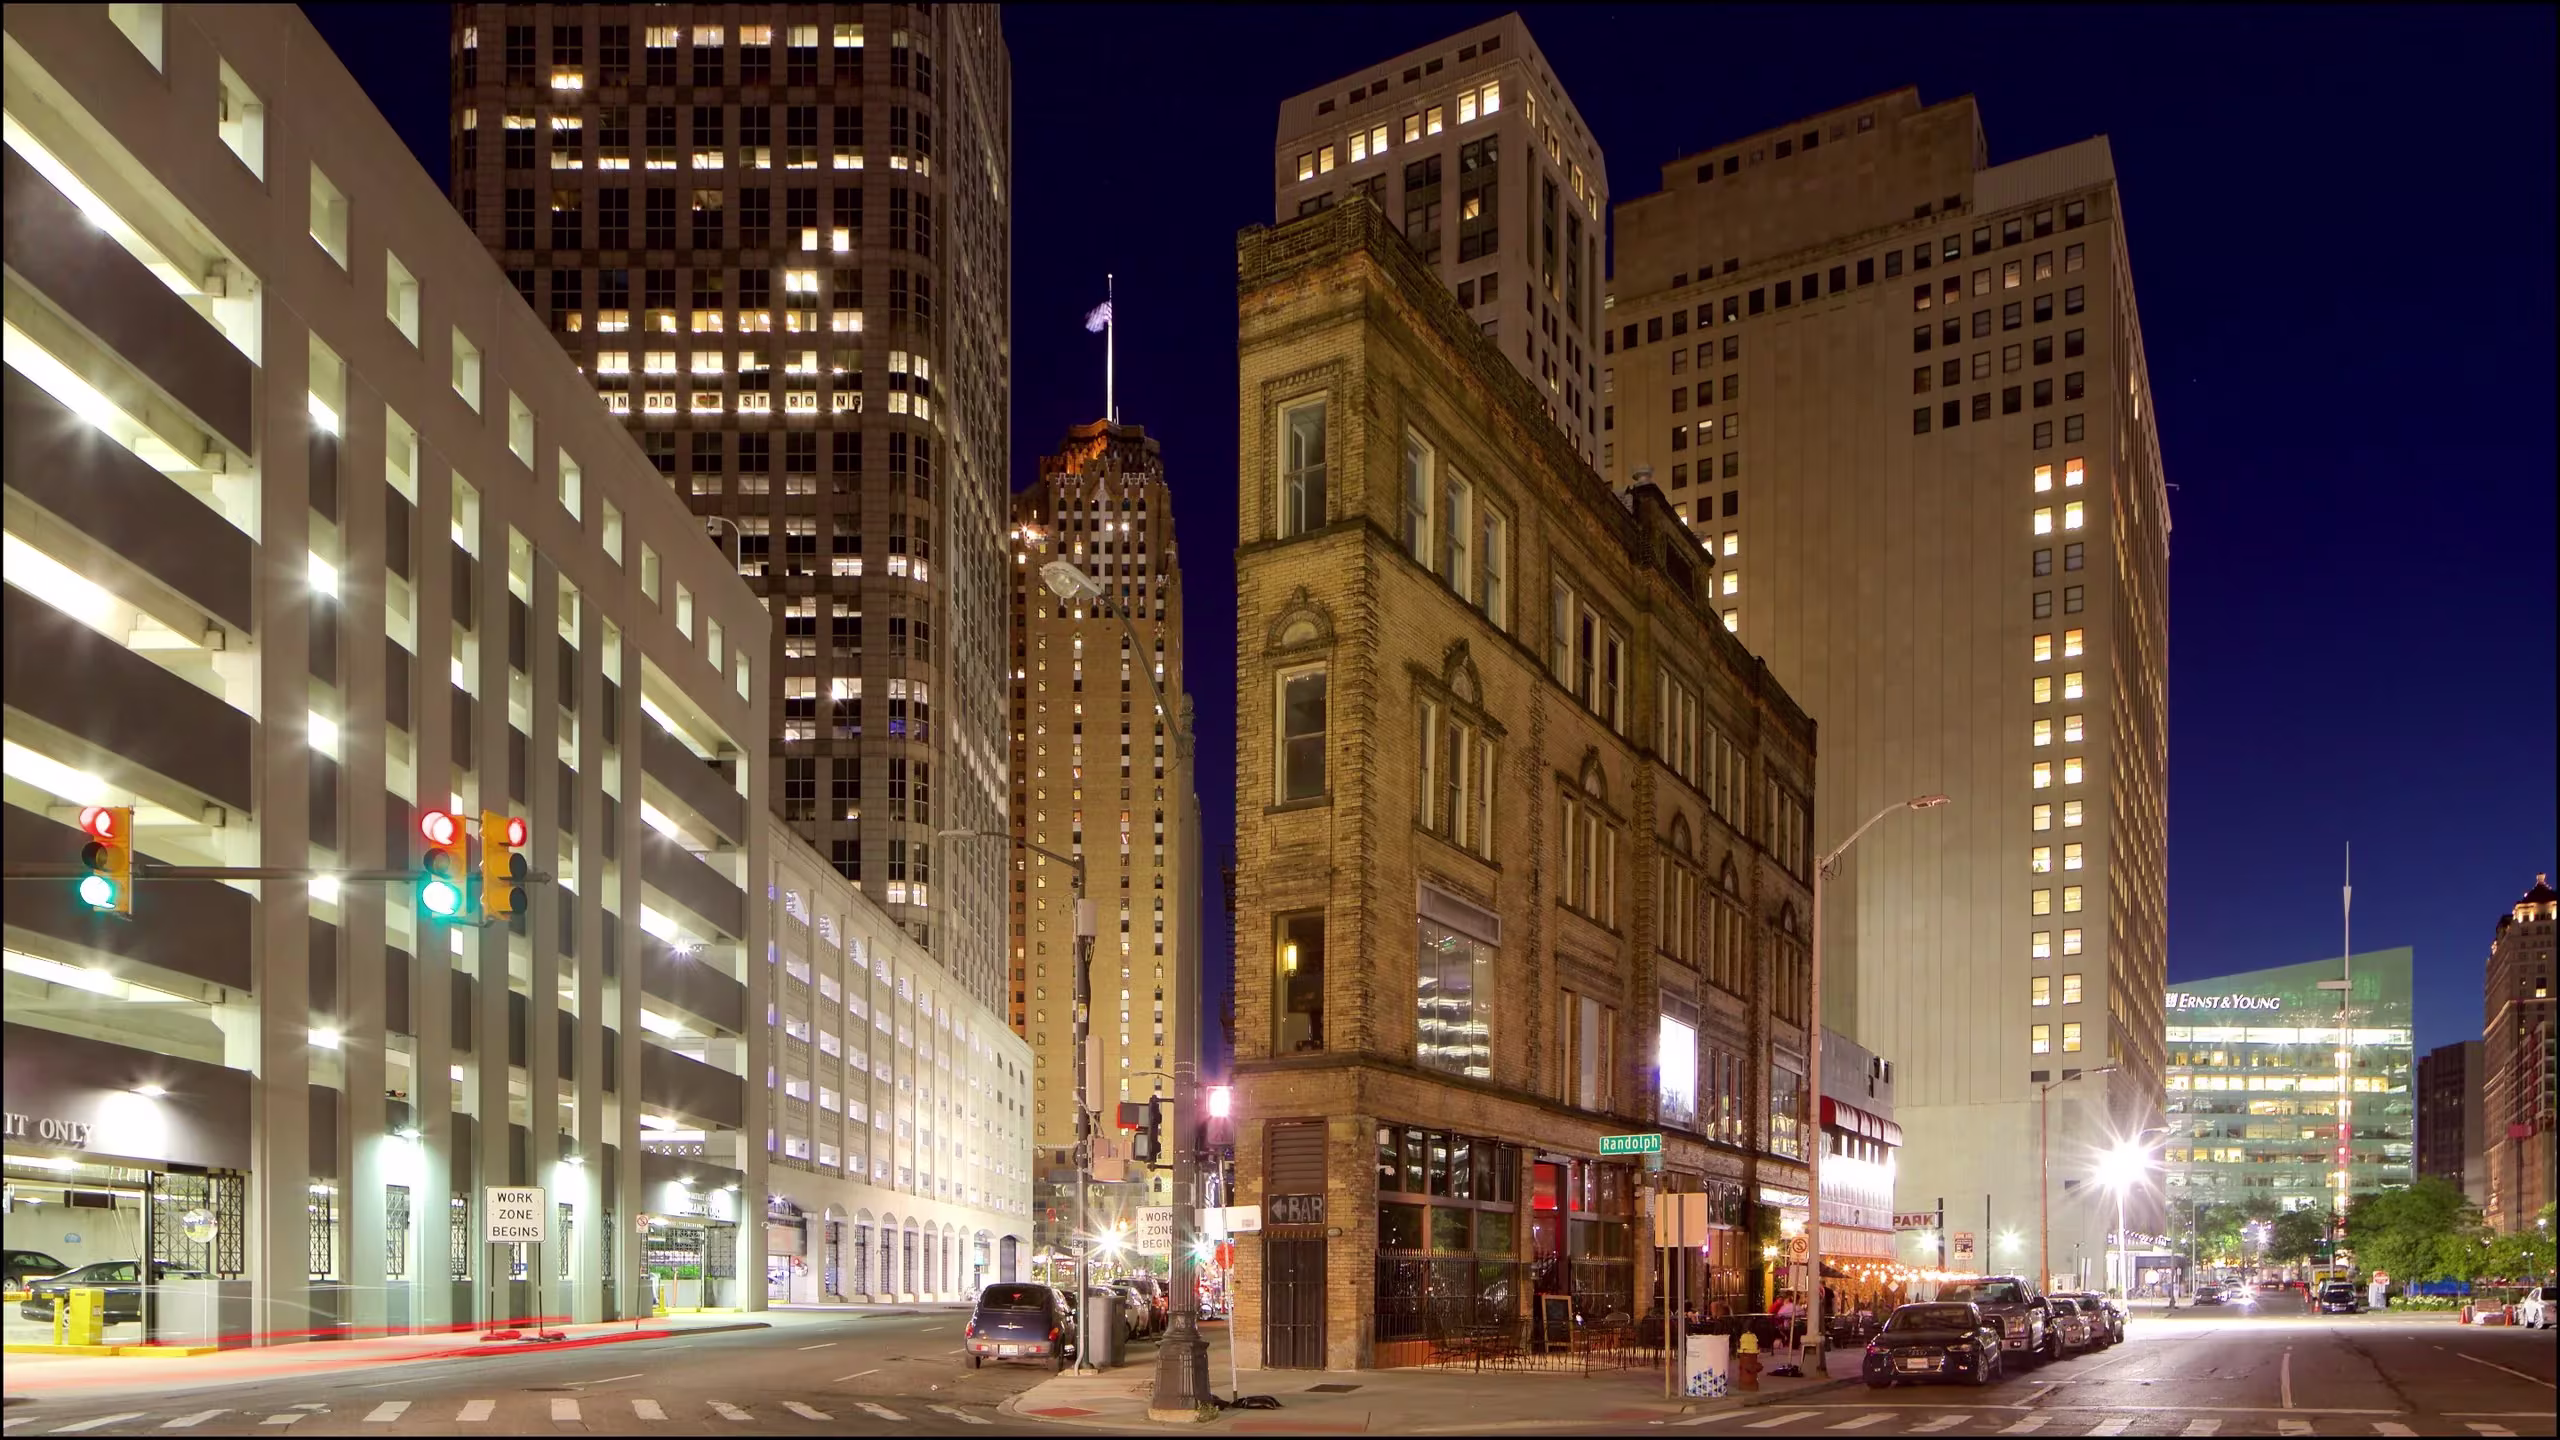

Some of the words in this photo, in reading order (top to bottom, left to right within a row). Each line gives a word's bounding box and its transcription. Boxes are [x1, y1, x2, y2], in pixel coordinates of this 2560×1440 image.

[2178, 993, 2220, 1009] ERNST
[2220, 996, 2231, 1009] &
[2232, 994, 2280, 1010] YOUNG
[4, 1112, 29, 1136] IT
[40, 1118, 94, 1143] ONLY
[1603, 1136, 1658, 1152] Randolph
[497, 1193, 533, 1203] WORK
[499, 1209, 533, 1219] ZONE
[1288, 1197, 1323, 1222] BAR
[1893, 1215, 1934, 1227] PARK
[492, 1226, 539, 1237] BEGINS
[1142, 1239, 1173, 1249] BEGIN
